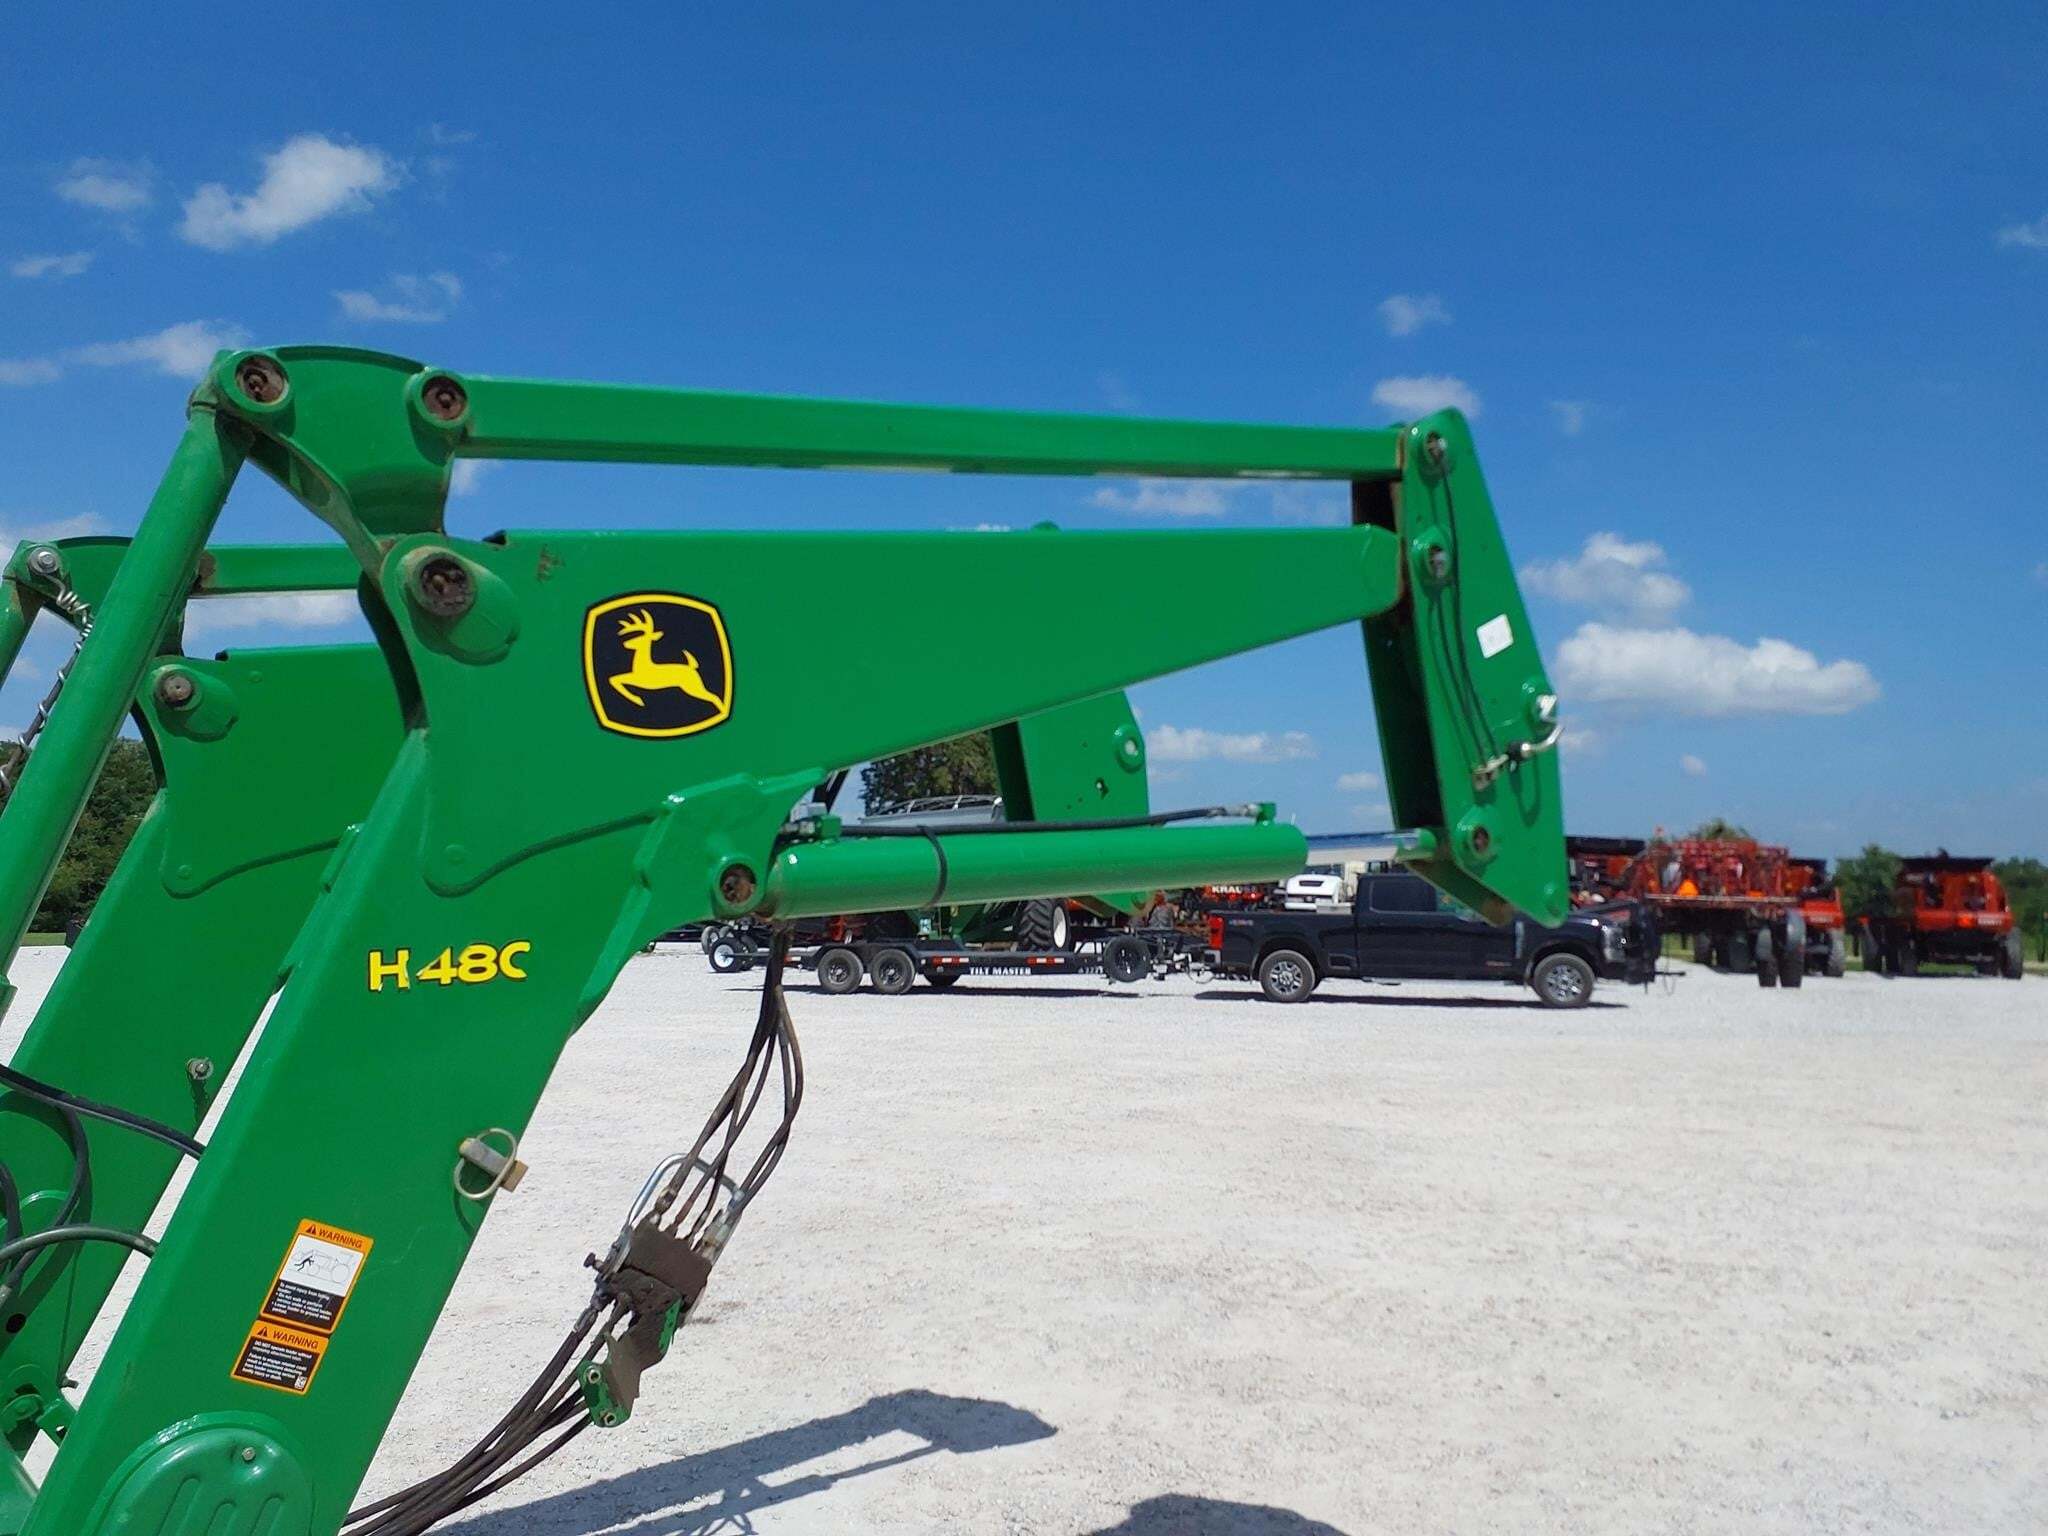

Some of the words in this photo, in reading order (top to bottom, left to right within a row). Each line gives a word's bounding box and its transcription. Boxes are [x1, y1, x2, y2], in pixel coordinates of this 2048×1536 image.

[969, 966, 990, 976] TILT
[991, 966, 1031, 976] MASTER
[319, 1229, 363, 1248] WARNING
[272, 1330, 319, 1349] WARNING
